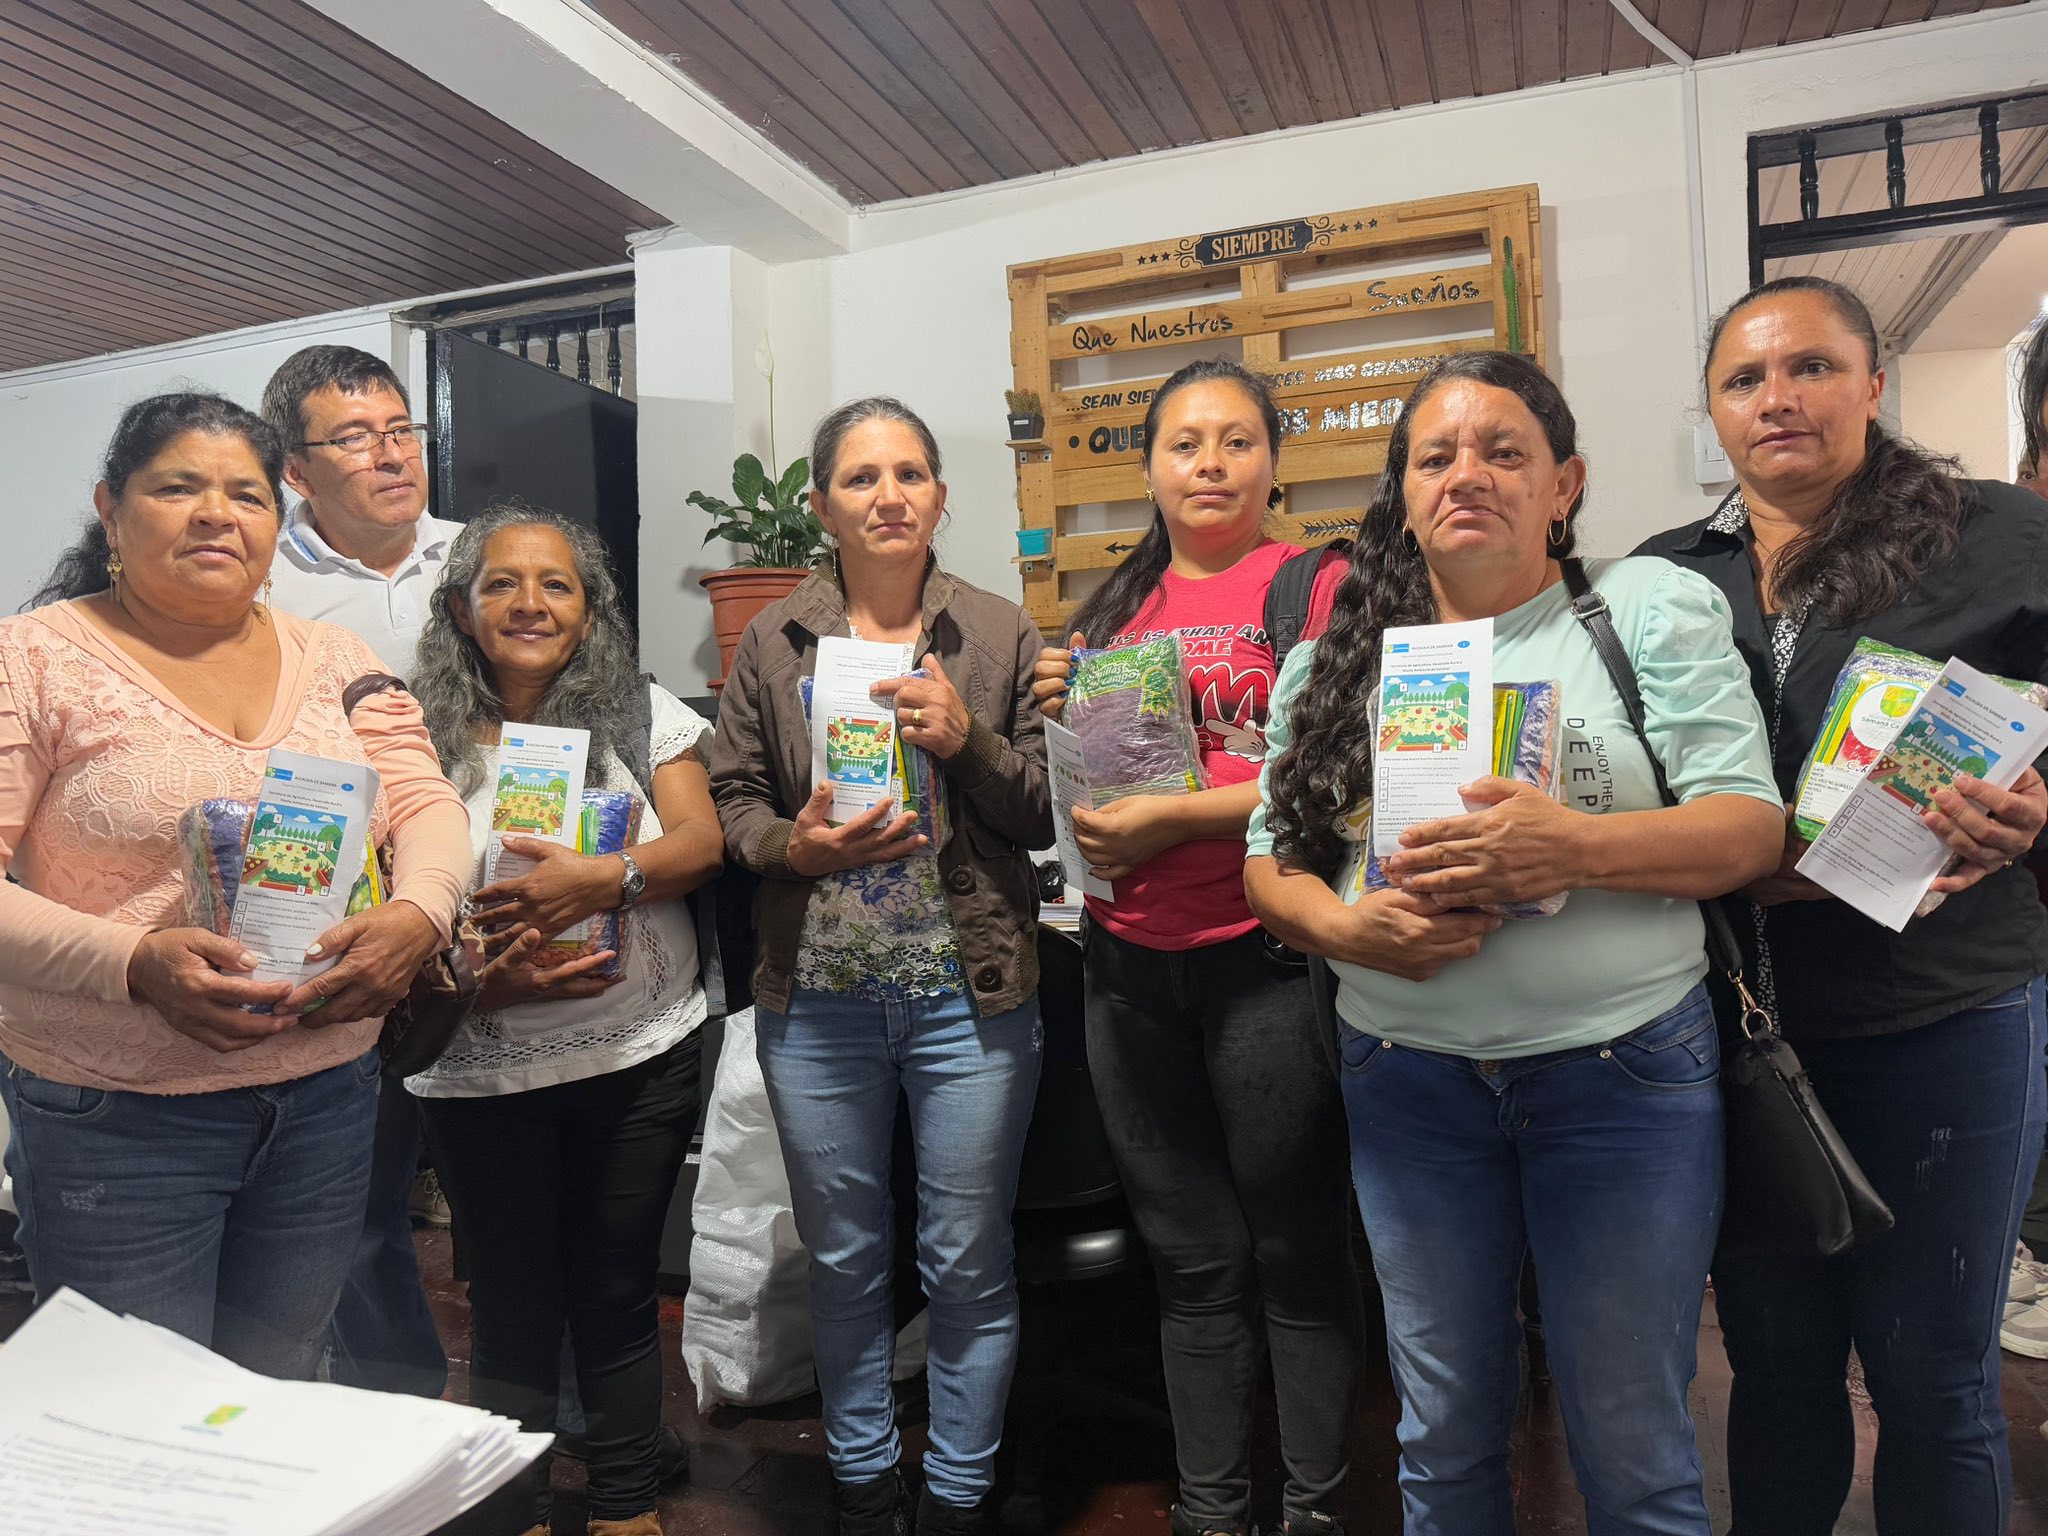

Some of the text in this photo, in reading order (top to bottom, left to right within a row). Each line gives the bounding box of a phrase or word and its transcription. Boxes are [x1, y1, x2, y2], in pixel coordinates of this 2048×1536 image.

[1211, 226, 1297, 261] SIEMPRE
[1366, 275, 1480, 311] Sueños
[1072, 310, 1233, 350] Que Nuestros
[1089, 424, 1145, 454] QUE
[1319, 398, 1404, 431] MIED
[1593, 736, 1610, 775] ENJOY
[1602, 778, 1613, 803] THE
